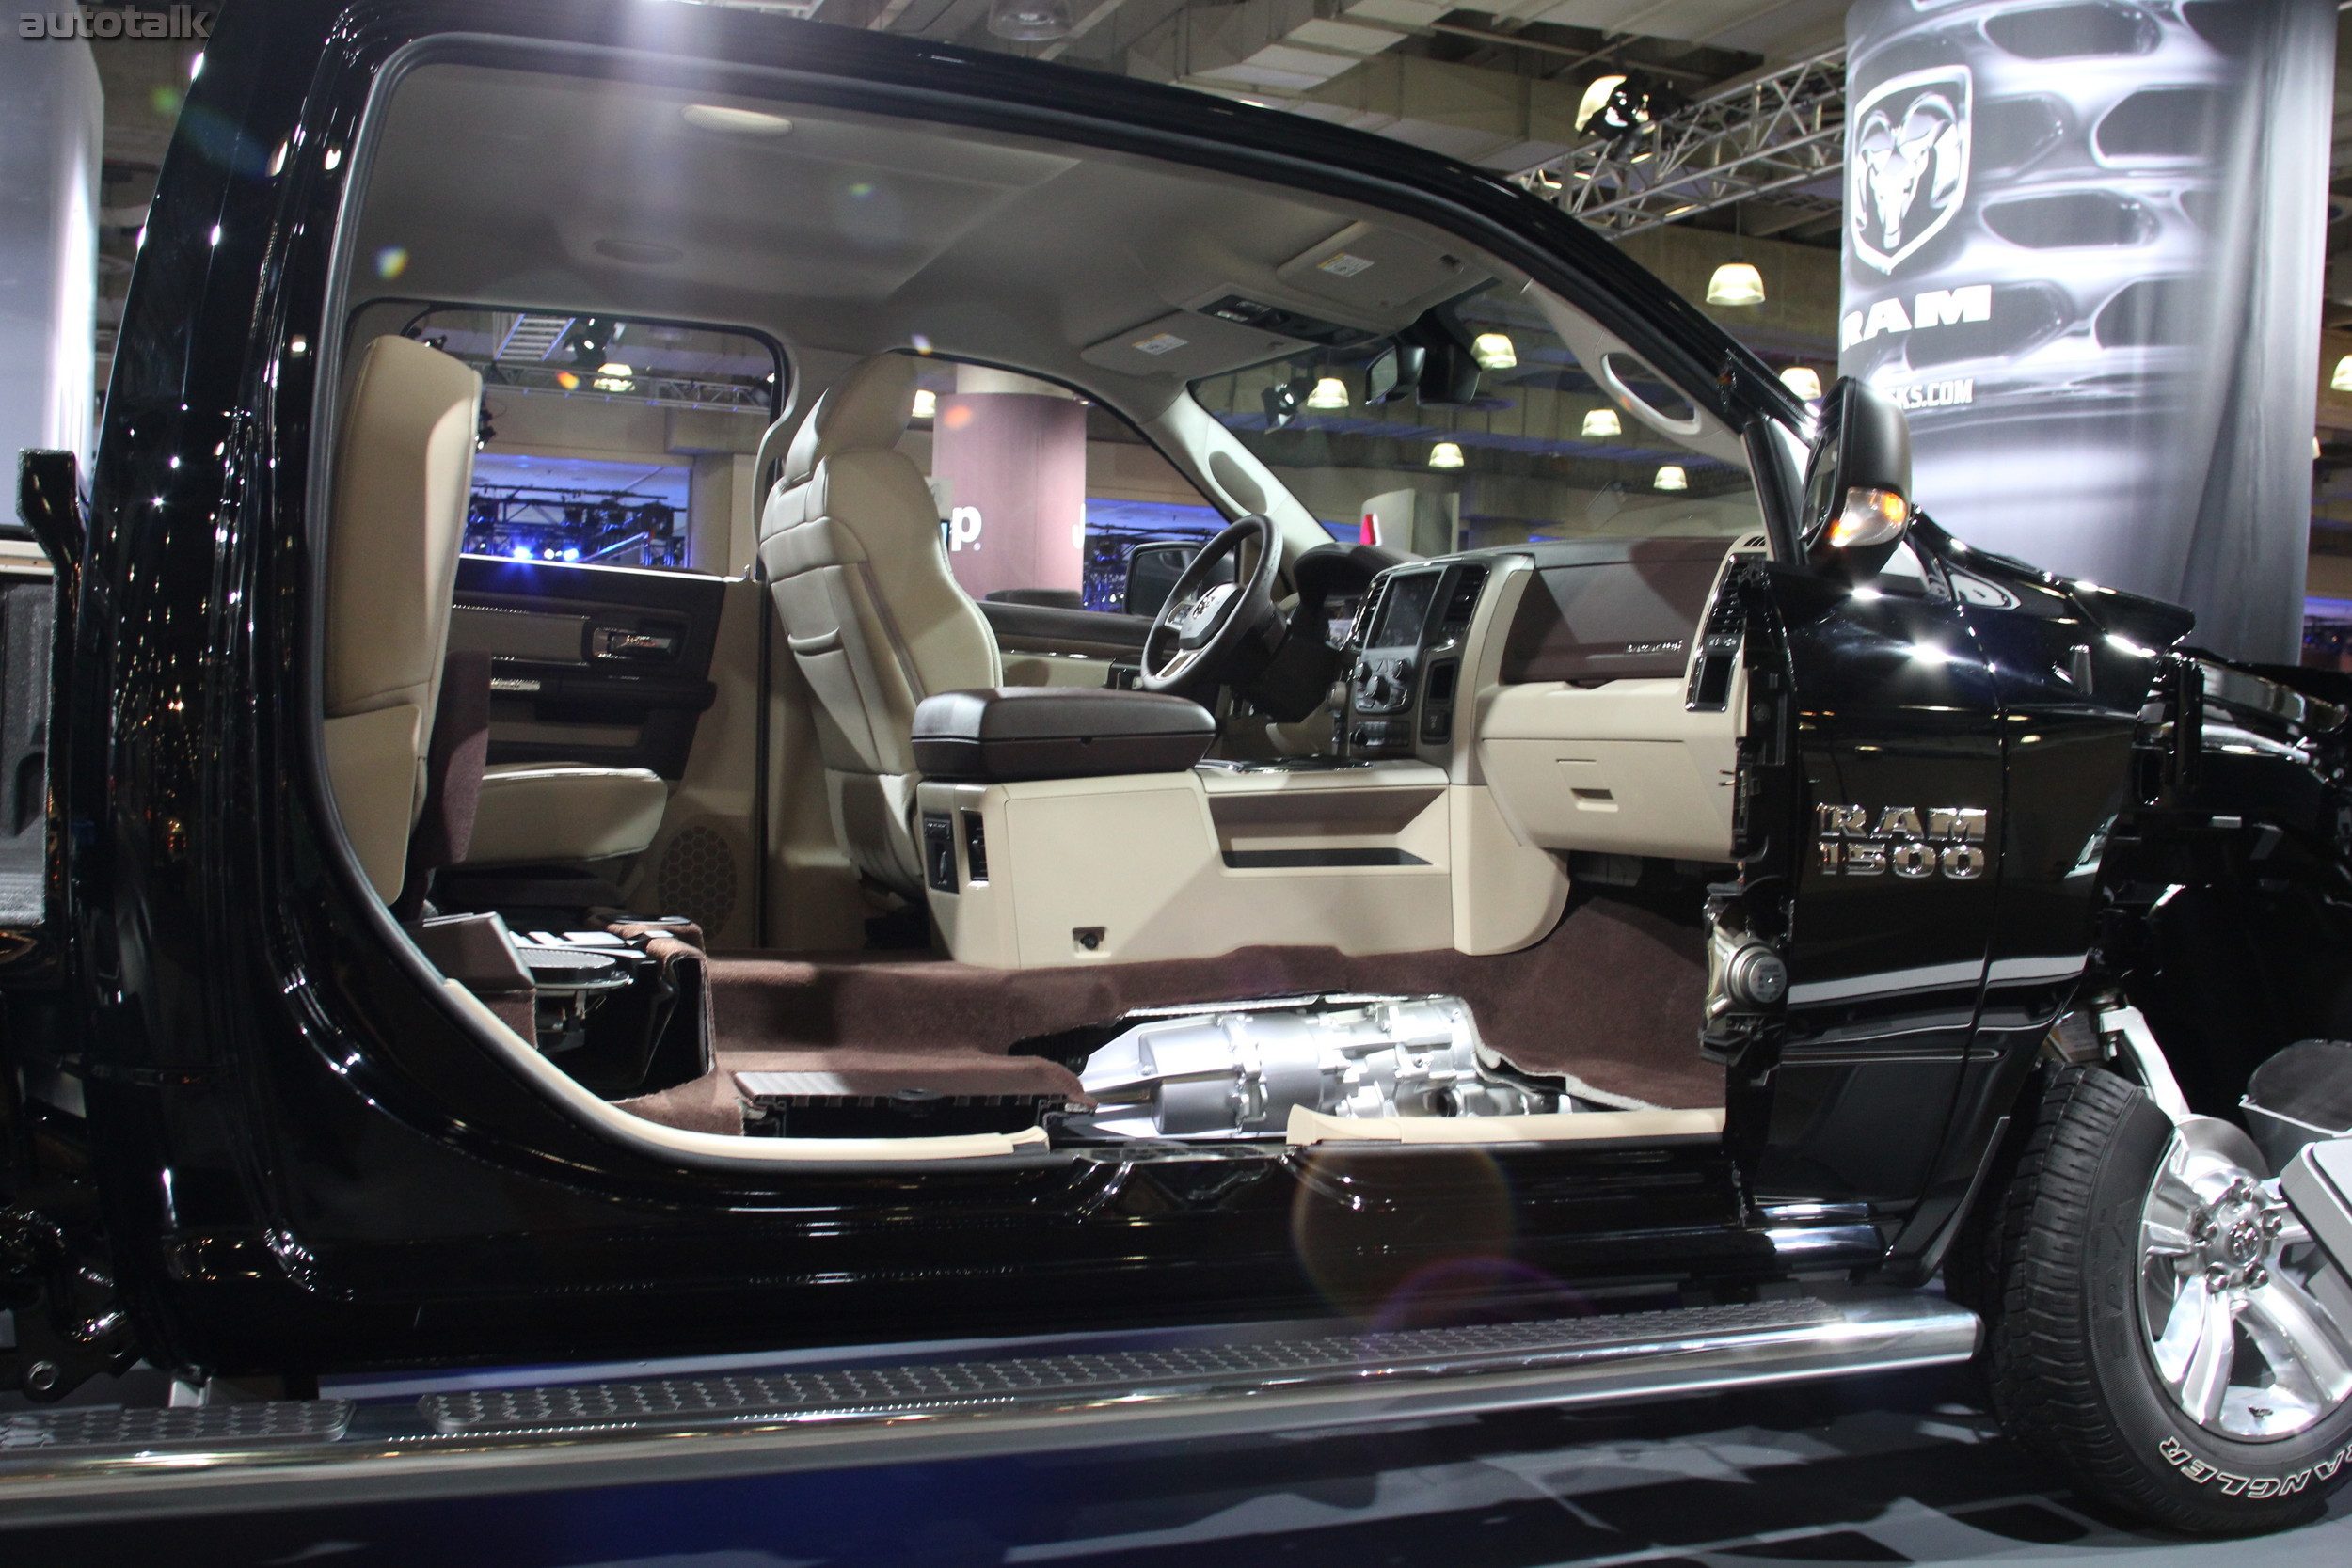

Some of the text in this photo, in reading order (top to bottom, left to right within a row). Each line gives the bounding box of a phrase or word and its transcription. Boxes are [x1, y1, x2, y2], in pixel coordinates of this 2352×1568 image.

[1841, 284, 1992, 353] RAM
[1884, 378, 1974, 410] KS.COM
[1817, 802, 1987, 842] RAM
[1818, 842, 1985, 880] 1500
[2159, 1435, 2352, 1498] ANGLER
